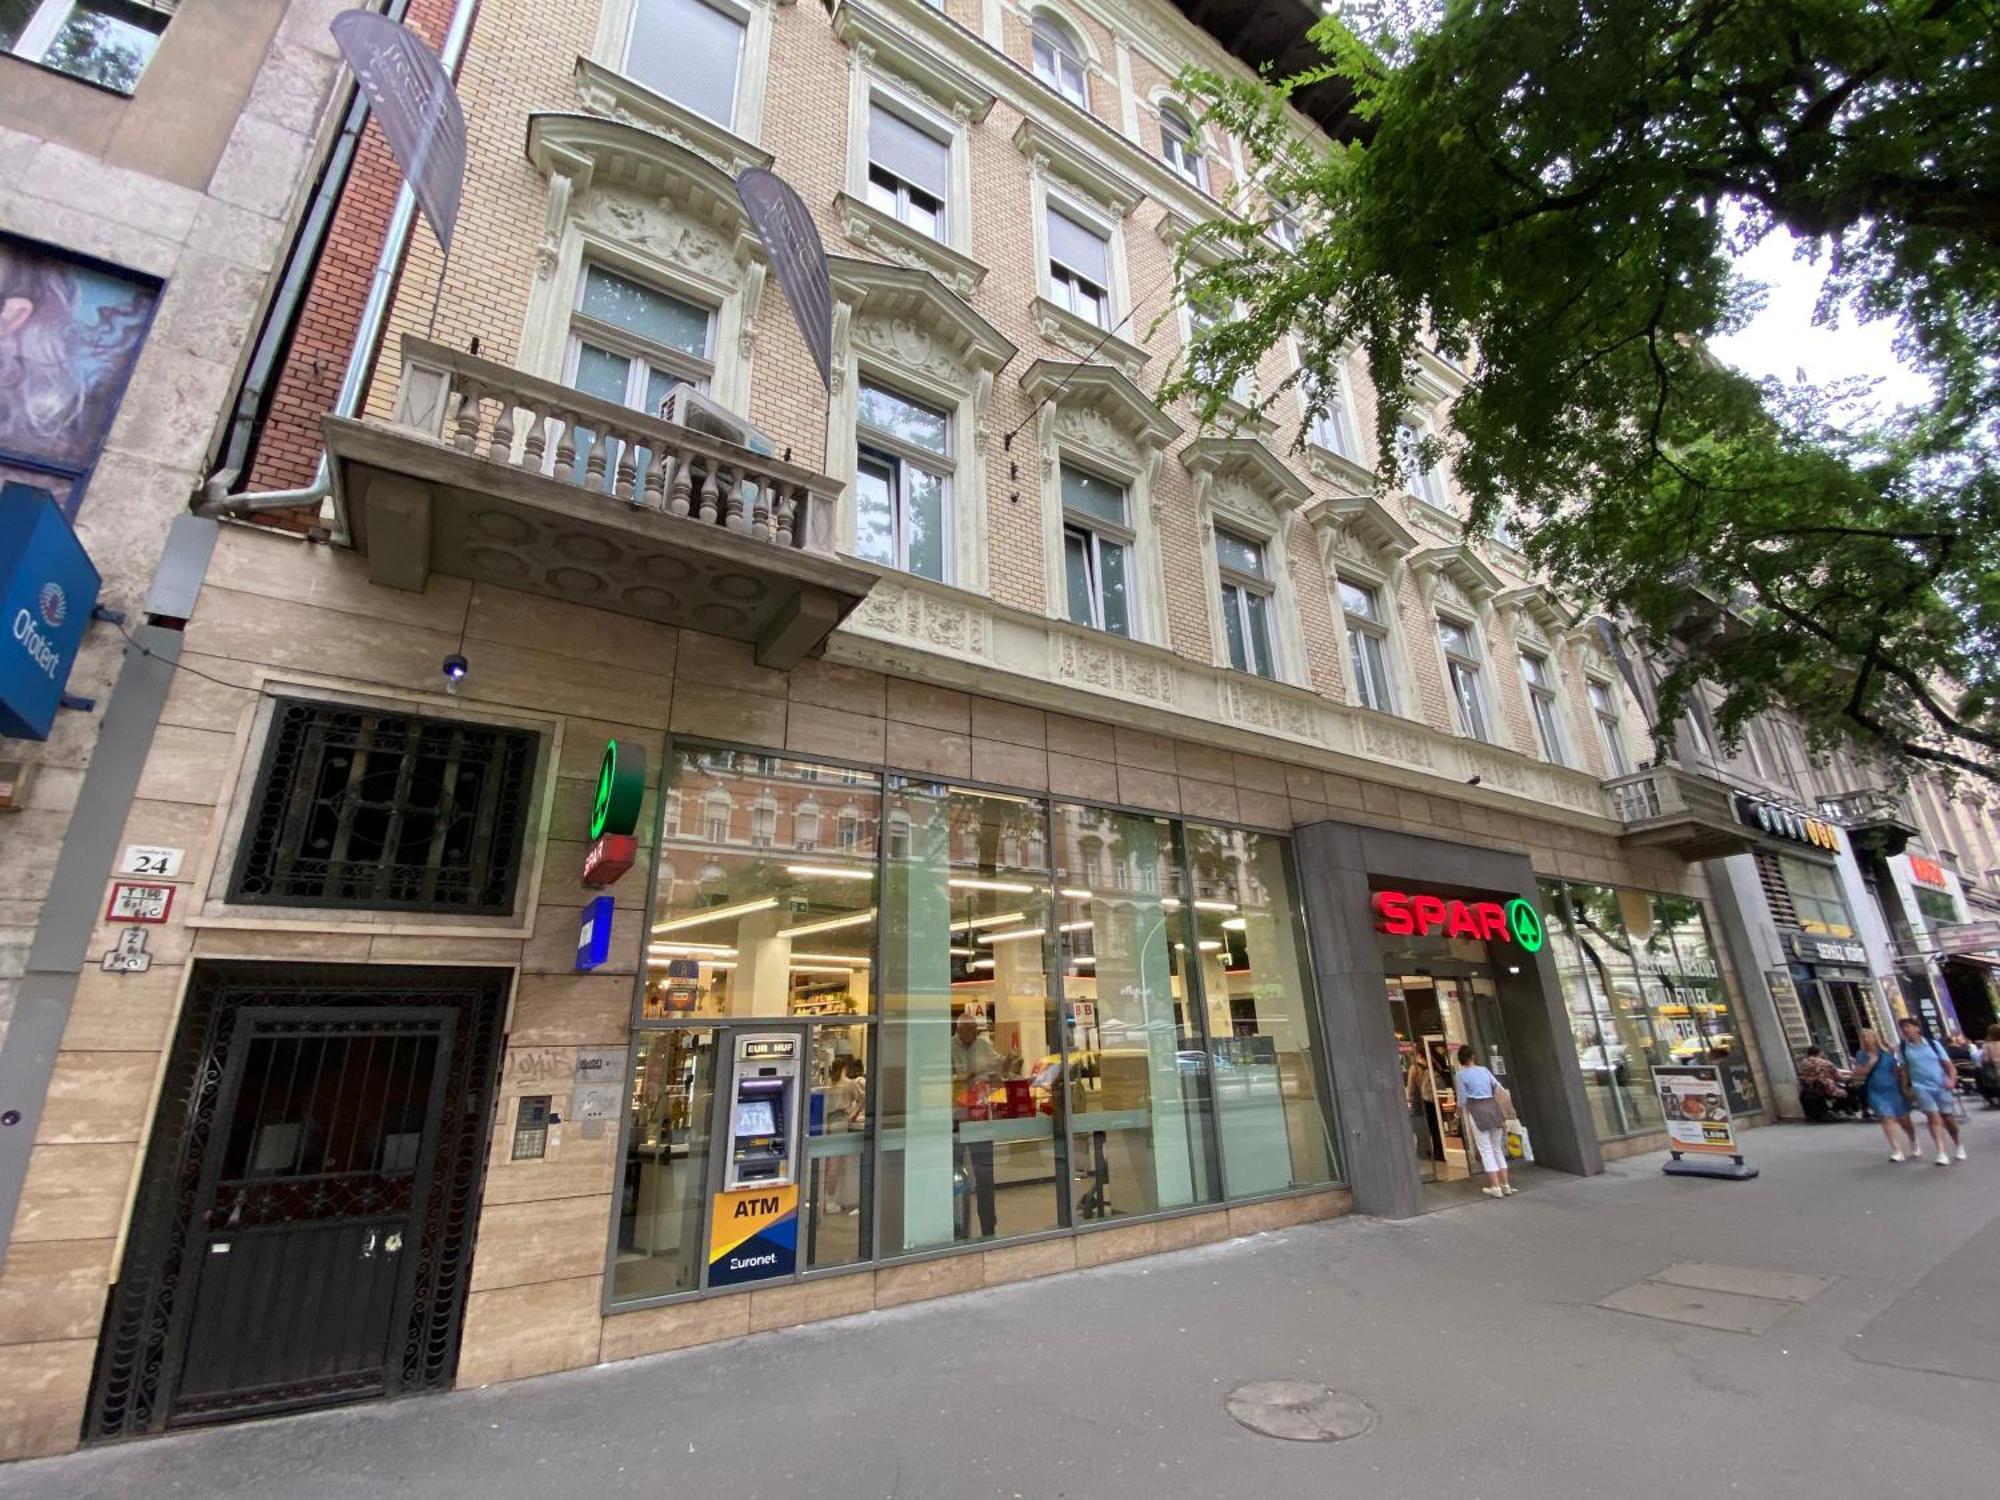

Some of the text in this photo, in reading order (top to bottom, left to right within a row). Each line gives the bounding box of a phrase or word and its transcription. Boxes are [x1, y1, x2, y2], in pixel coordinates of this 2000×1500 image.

[13, 608, 60, 679] Ofotért
[133, 855, 168, 874] 24
[1372, 891, 1510, 943] SPAR
[976, 1004, 984, 1016] A
[1084, 1004, 1093, 1016] B
[773, 1043, 793, 1052] HUF
[734, 1197, 779, 1218] ATM
[730, 1253, 777, 1270] Euronet
